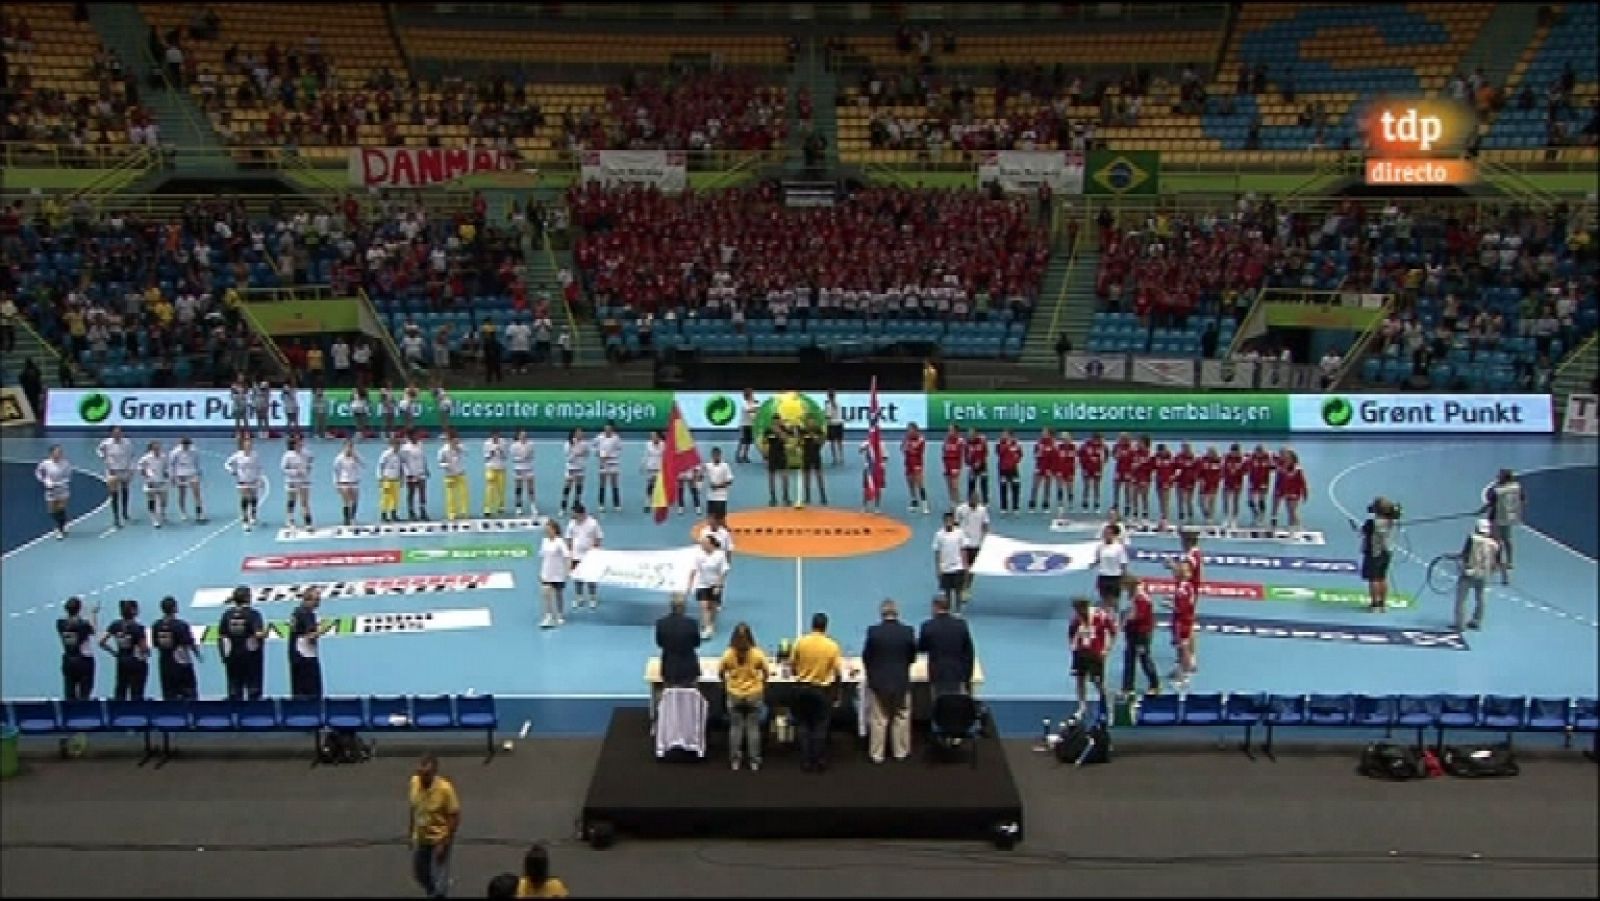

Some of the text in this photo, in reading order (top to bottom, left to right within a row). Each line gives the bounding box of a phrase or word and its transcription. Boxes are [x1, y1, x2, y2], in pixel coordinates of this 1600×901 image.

[120, 397, 281, 420] Grønt Put
[446, 399, 538, 419] ildesorter
[545, 399, 656, 424] emballasjen
[841, 402, 898, 422] unkt
[943, 400, 988, 420] Tenk
[993, 399, 1037, 424] miljø
[1053, 400, 1153, 420] kildesorter
[1159, 400, 1271, 425] emballasjen
[1360, 400, 1523, 424] Grønt Punkt
